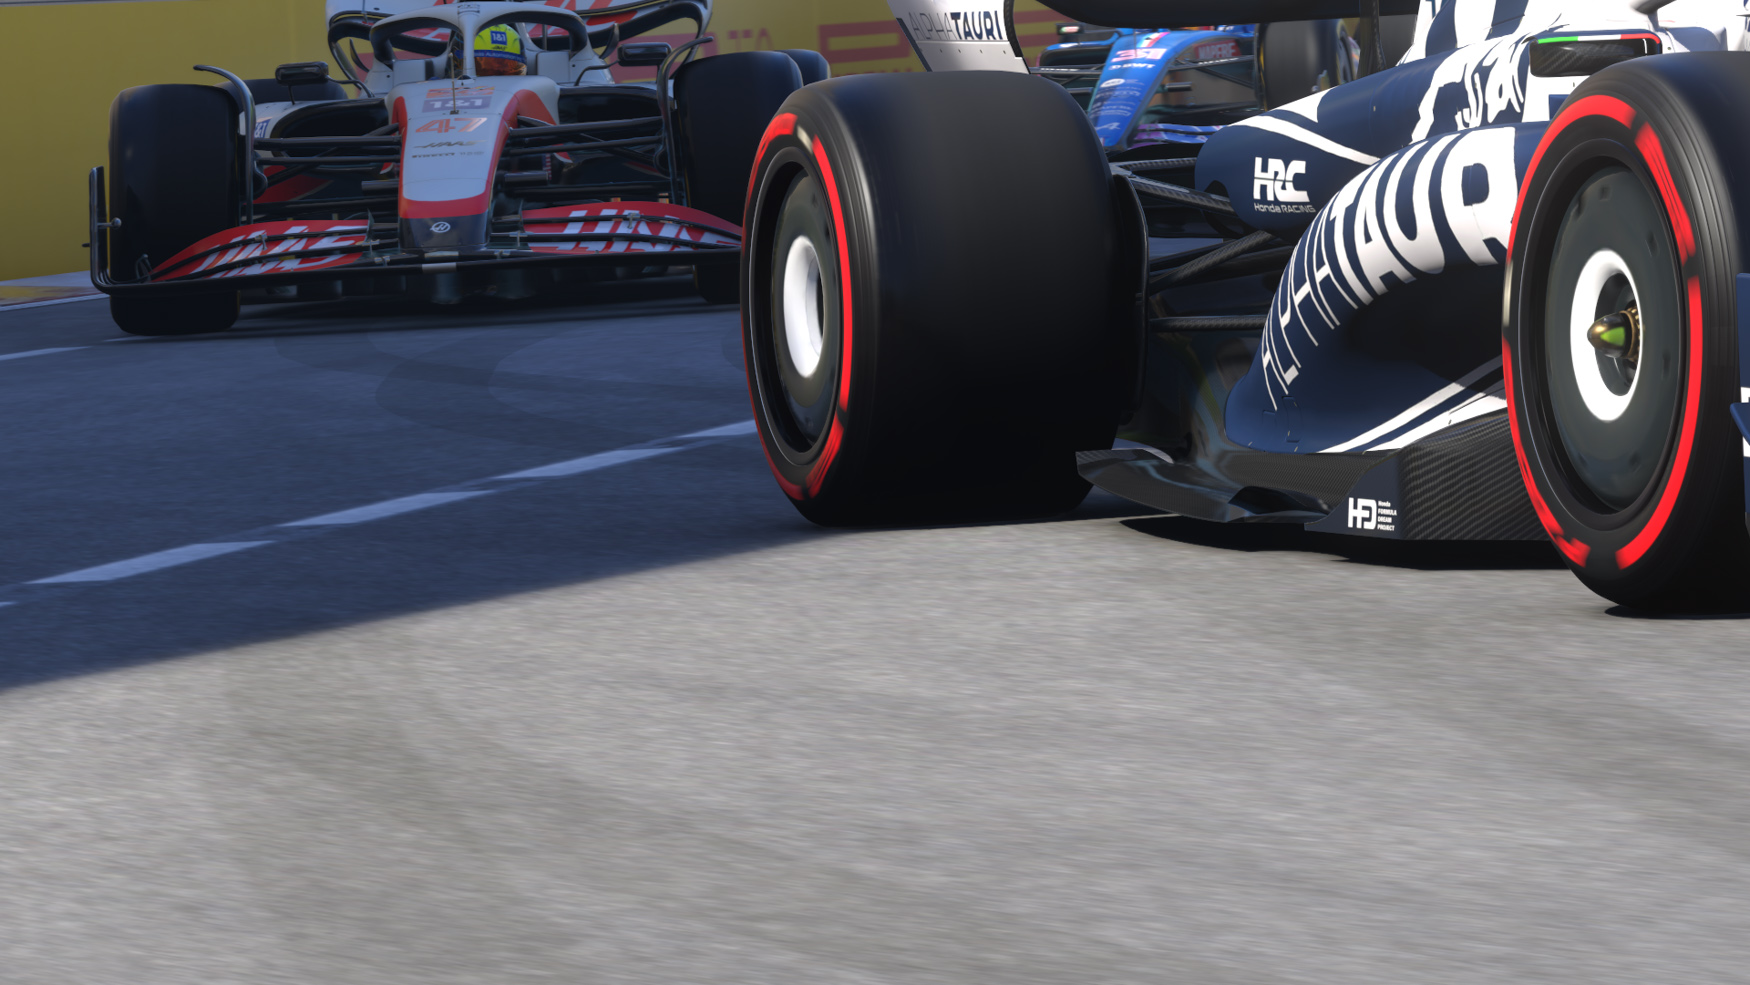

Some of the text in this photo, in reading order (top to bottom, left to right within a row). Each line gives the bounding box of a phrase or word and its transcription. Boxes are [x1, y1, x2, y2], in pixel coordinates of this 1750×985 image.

[908, 10, 1003, 40] ALPHATAURI
[1111, 48, 1167, 62] 31
[415, 117, 488, 133] 47
[1253, 156, 1310, 203] HRC
[1254, 203, 1316, 214] Honda RACING
[1261, 126, 1519, 411] ALPHATAUR
